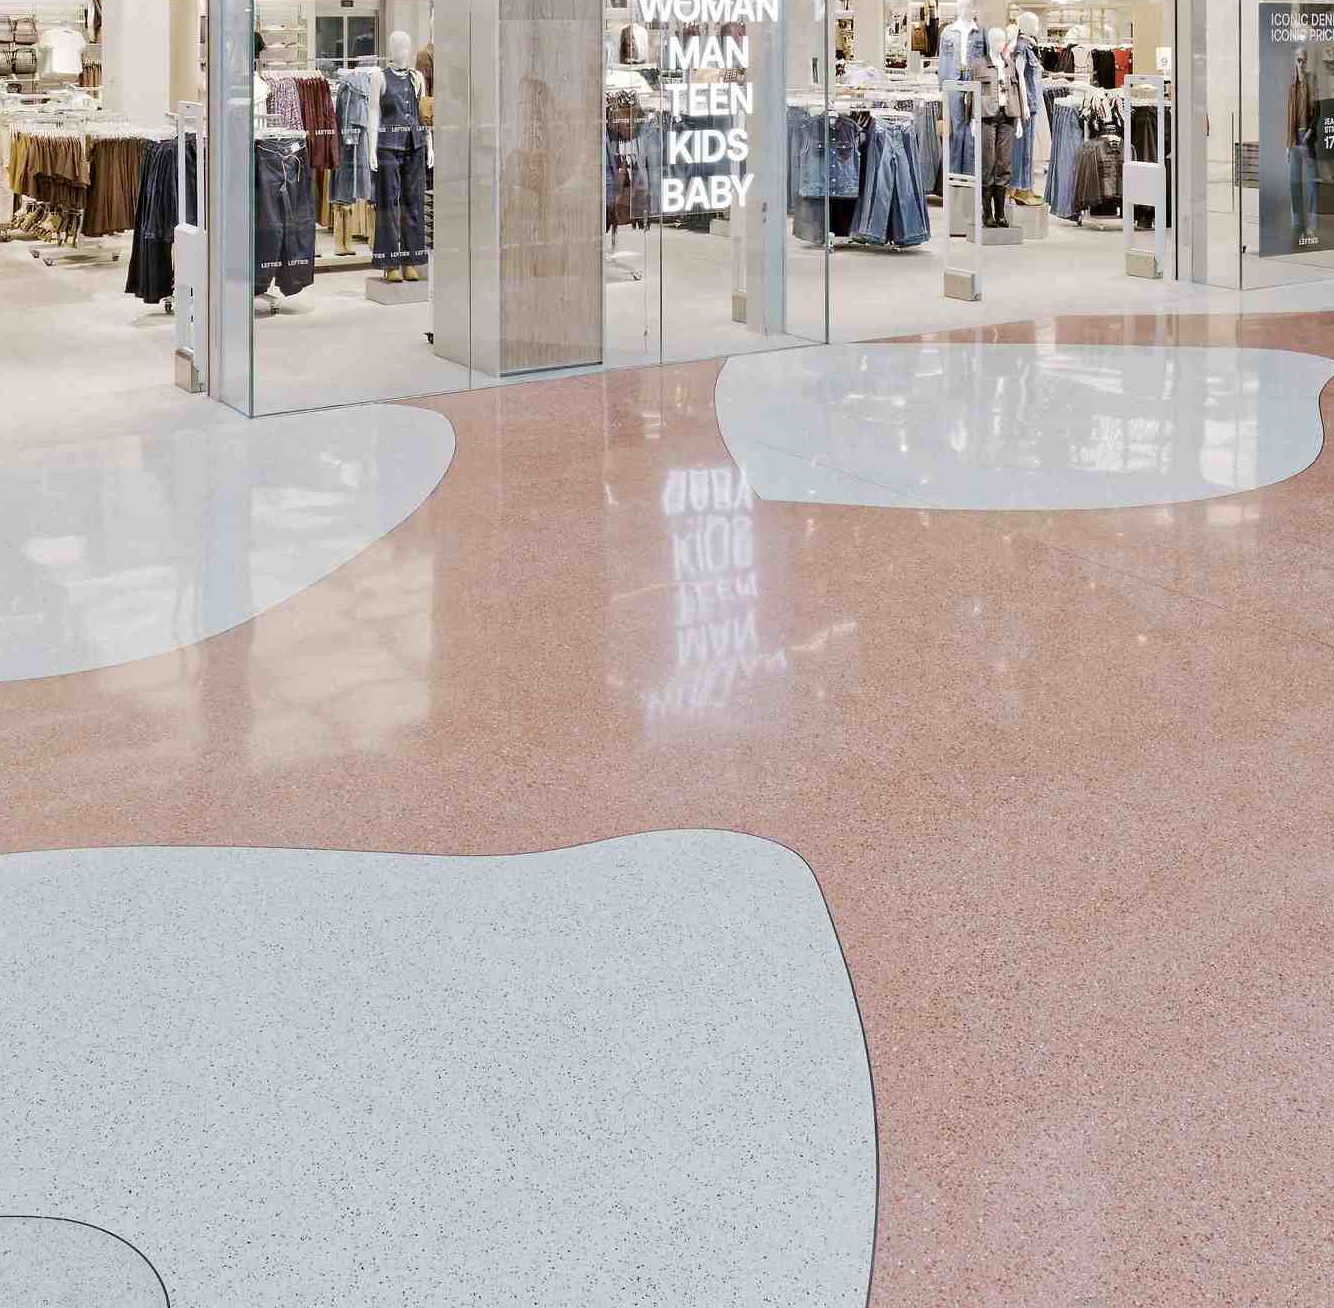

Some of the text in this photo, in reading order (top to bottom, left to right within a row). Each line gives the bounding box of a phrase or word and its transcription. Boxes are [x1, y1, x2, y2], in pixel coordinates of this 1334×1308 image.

[669, 36, 750, 69] MAN
[666, 82, 754, 117] TEEN
[669, 128, 749, 165] KIDS
[662, 173, 754, 212] BABY
